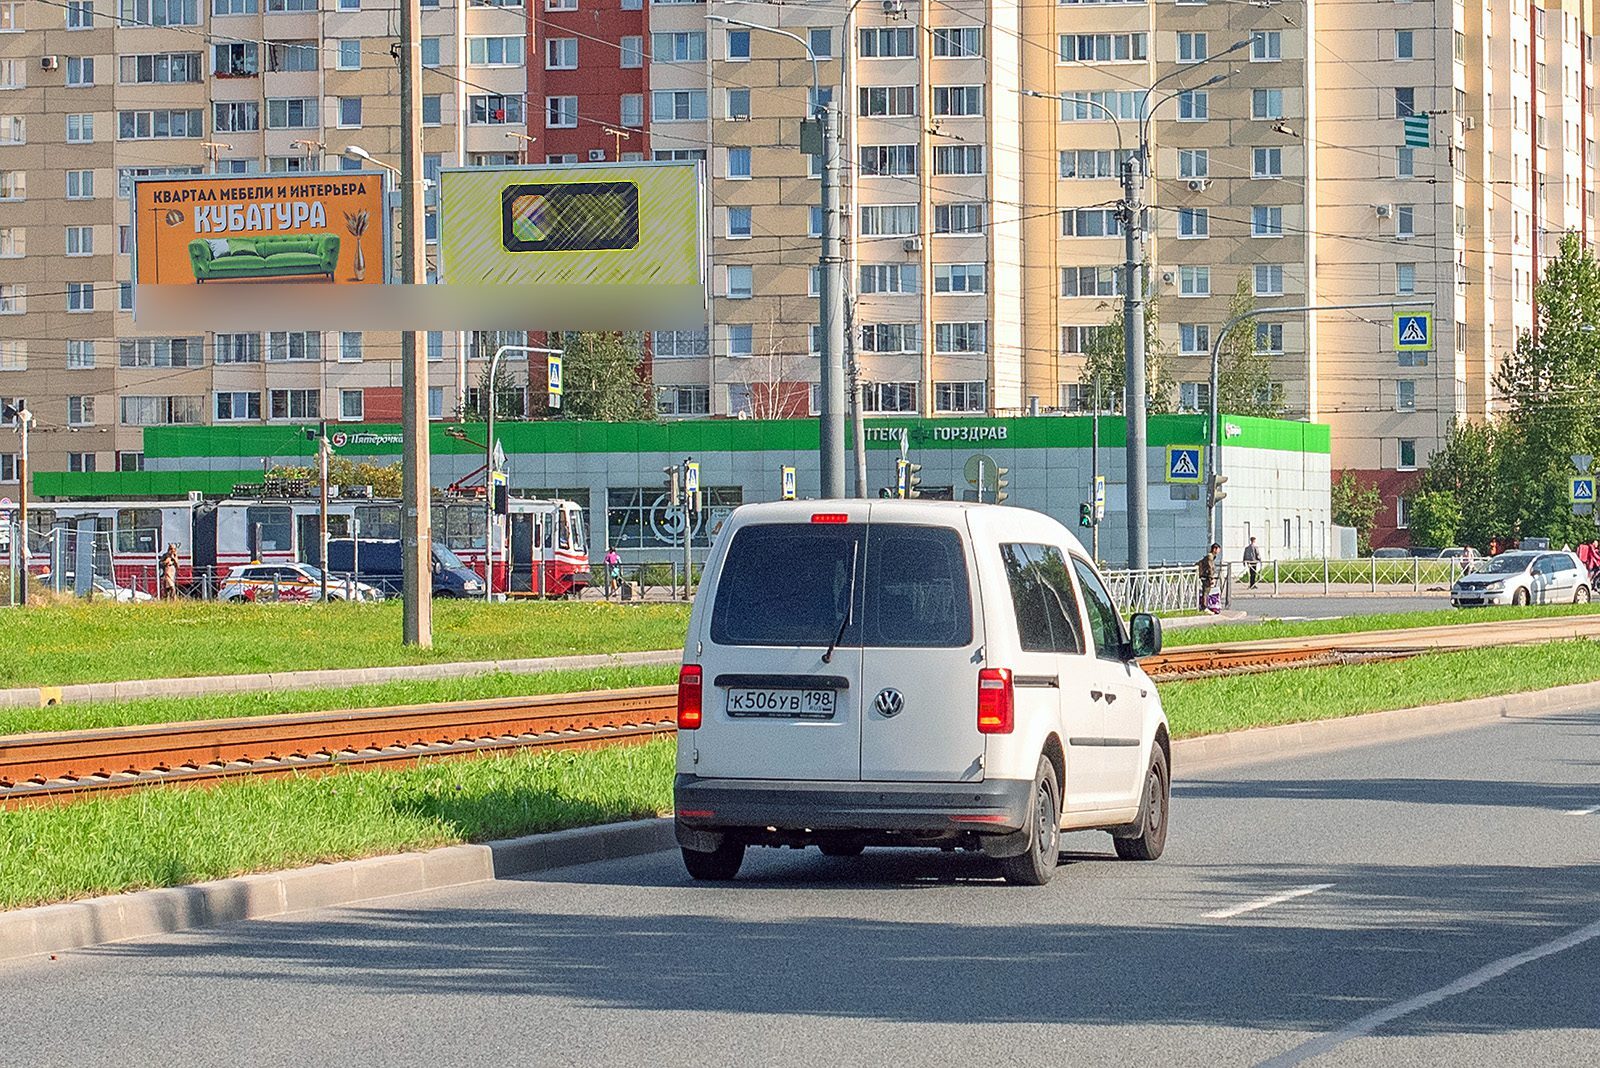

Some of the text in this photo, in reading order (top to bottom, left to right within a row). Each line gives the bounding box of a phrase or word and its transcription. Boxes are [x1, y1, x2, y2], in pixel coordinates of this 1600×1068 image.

[153, 182, 366, 203] КВАРТАЛ МЕБЕЛИ И ИНТЕРЬЕРА
[193, 201, 327, 233] КУБАТУРА
[864, 426, 1008, 442] ПТЕКИ ГОРЗДРАВ
[804, 691, 831, 706] 198
